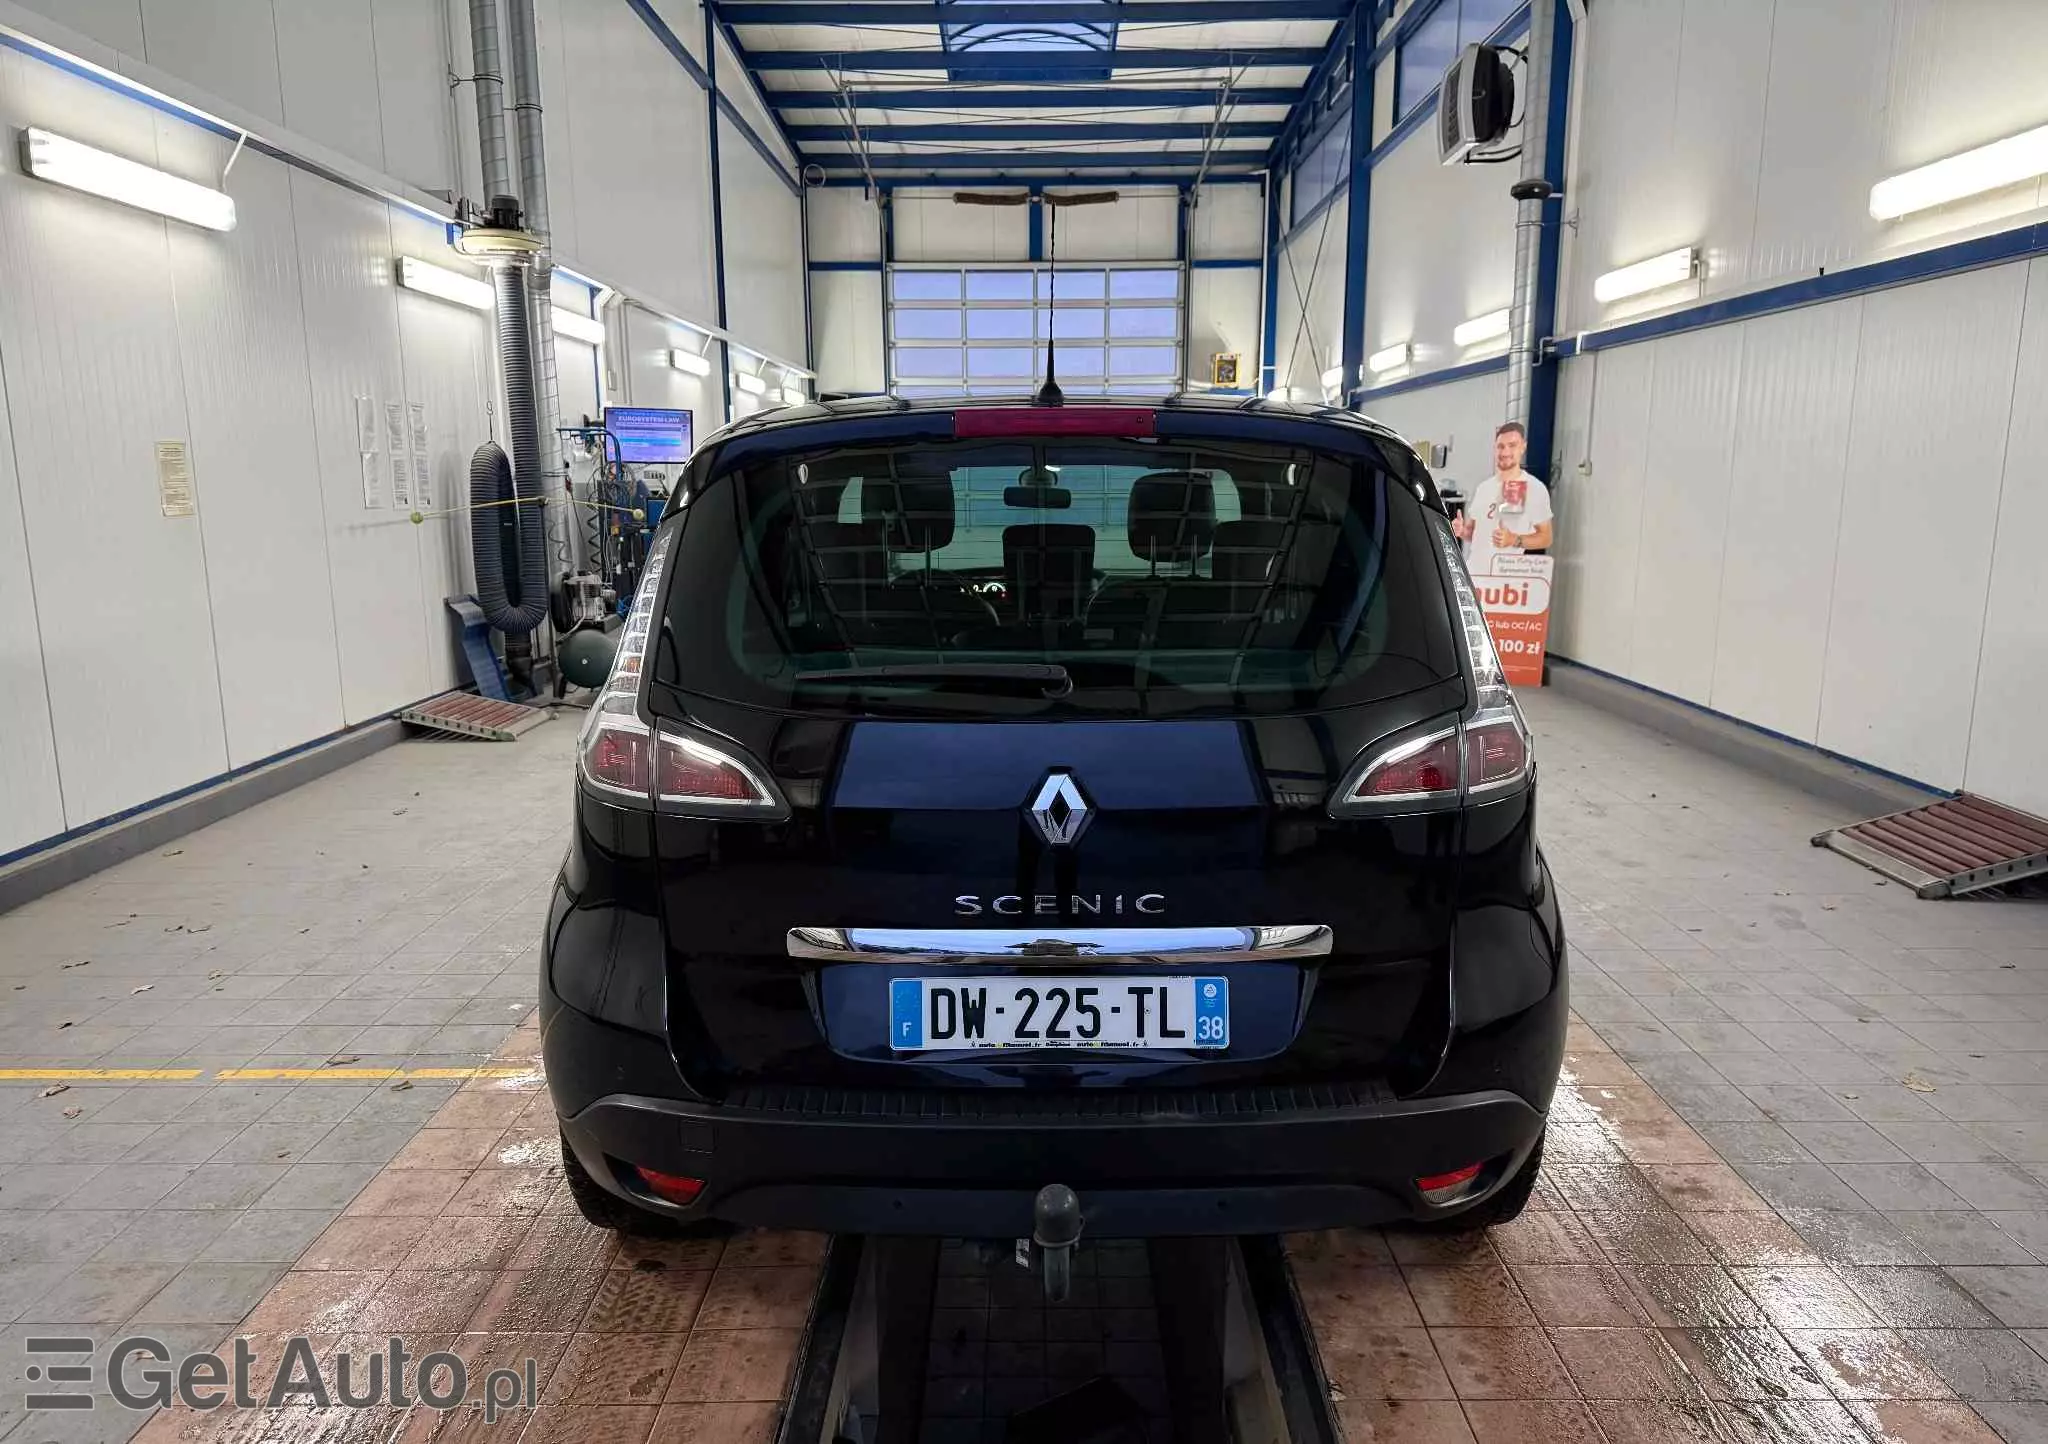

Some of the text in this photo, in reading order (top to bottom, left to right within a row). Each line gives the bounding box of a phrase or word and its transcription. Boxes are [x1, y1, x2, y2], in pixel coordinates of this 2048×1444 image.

[1511, 620, 1543, 633] OC/AC
[1499, 638, 1541, 655] 100 zł
[954, 893, 1166, 915] SCENIC
[930, 986, 1186, 1040] DW-225-TL
[902, 1022, 912, 1037] F
[1198, 1015, 1224, 1040] 38
